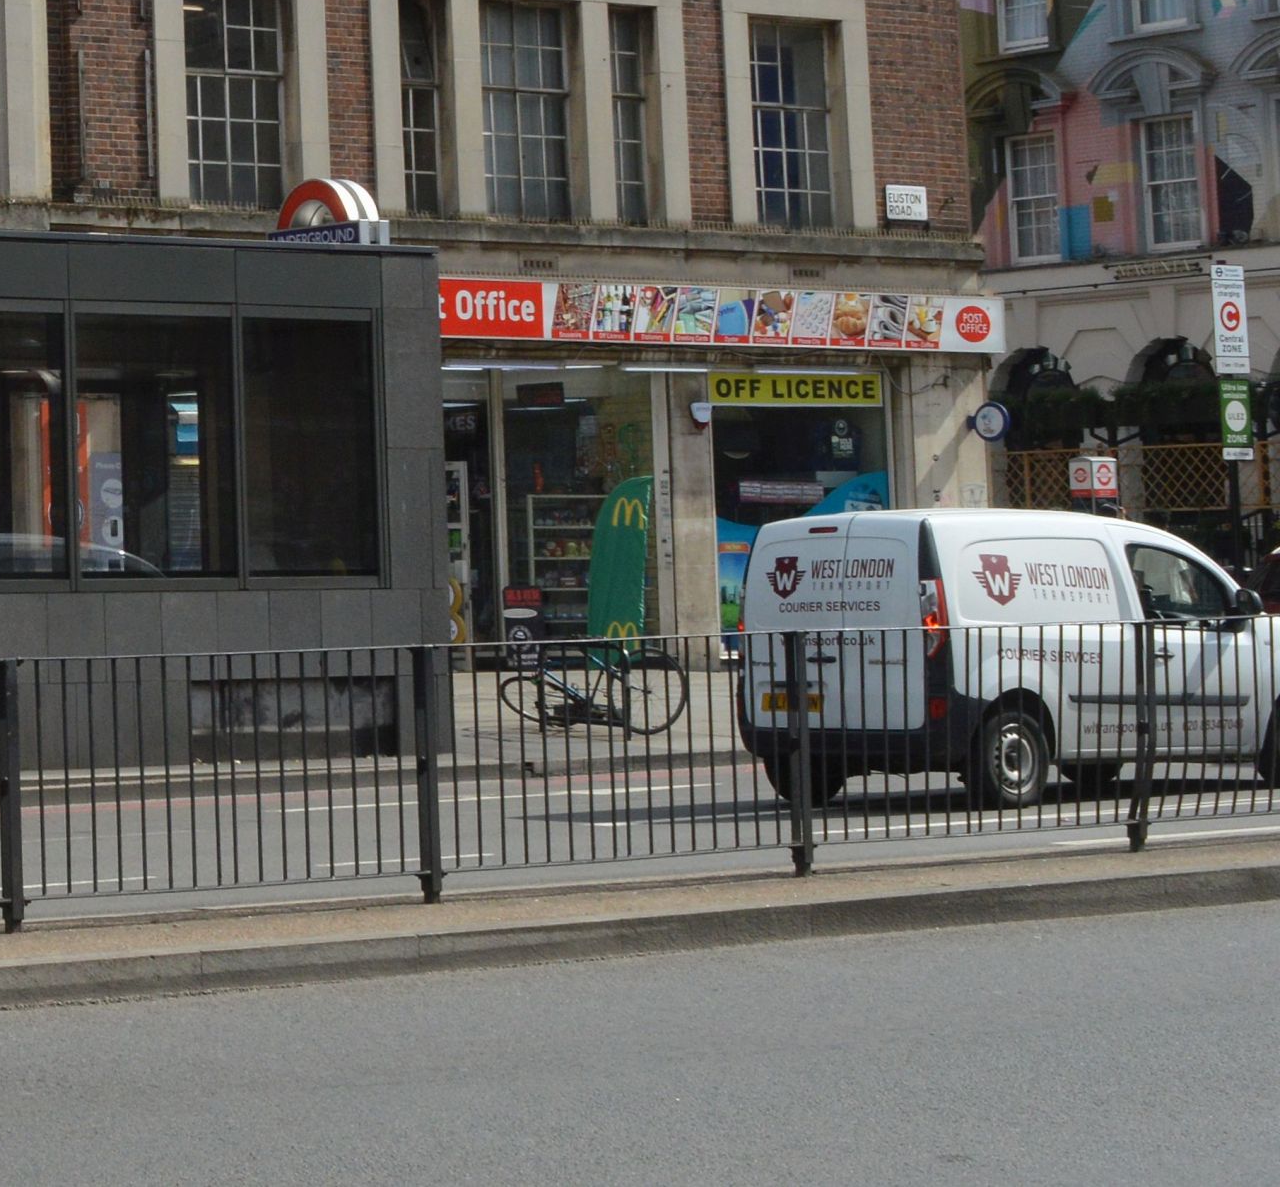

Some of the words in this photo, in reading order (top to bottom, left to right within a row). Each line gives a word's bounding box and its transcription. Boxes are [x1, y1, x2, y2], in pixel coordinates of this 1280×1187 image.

[888, 193, 922, 205] EUSTON
[889, 205, 912, 216] ROAD
[1214, 282, 1243, 290] Congestion
[455, 290, 536, 322] Office
[962, 312, 984, 323] POST
[959, 323, 989, 334] OFFICE
[1219, 334, 1244, 343] Central
[1222, 344, 1243, 353] ZONE
[715, 378, 761, 398] OFF
[771, 379, 876, 399] LICENCE
[1228, 412, 1245, 421] ULEZ
[1227, 434, 1249, 443] ZONE
[811, 559, 842, 579] WEST
[845, 558, 895, 579] LONDON
[1025, 562, 1059, 587] WEST
[1061, 564, 1110, 590] LONDON
[812, 580, 890, 591] TRANSPORT
[1033, 588, 1111, 604] TRANSPORT
[779, 601, 823, 613] COURIER
[826, 600, 881, 613] SERVICES
